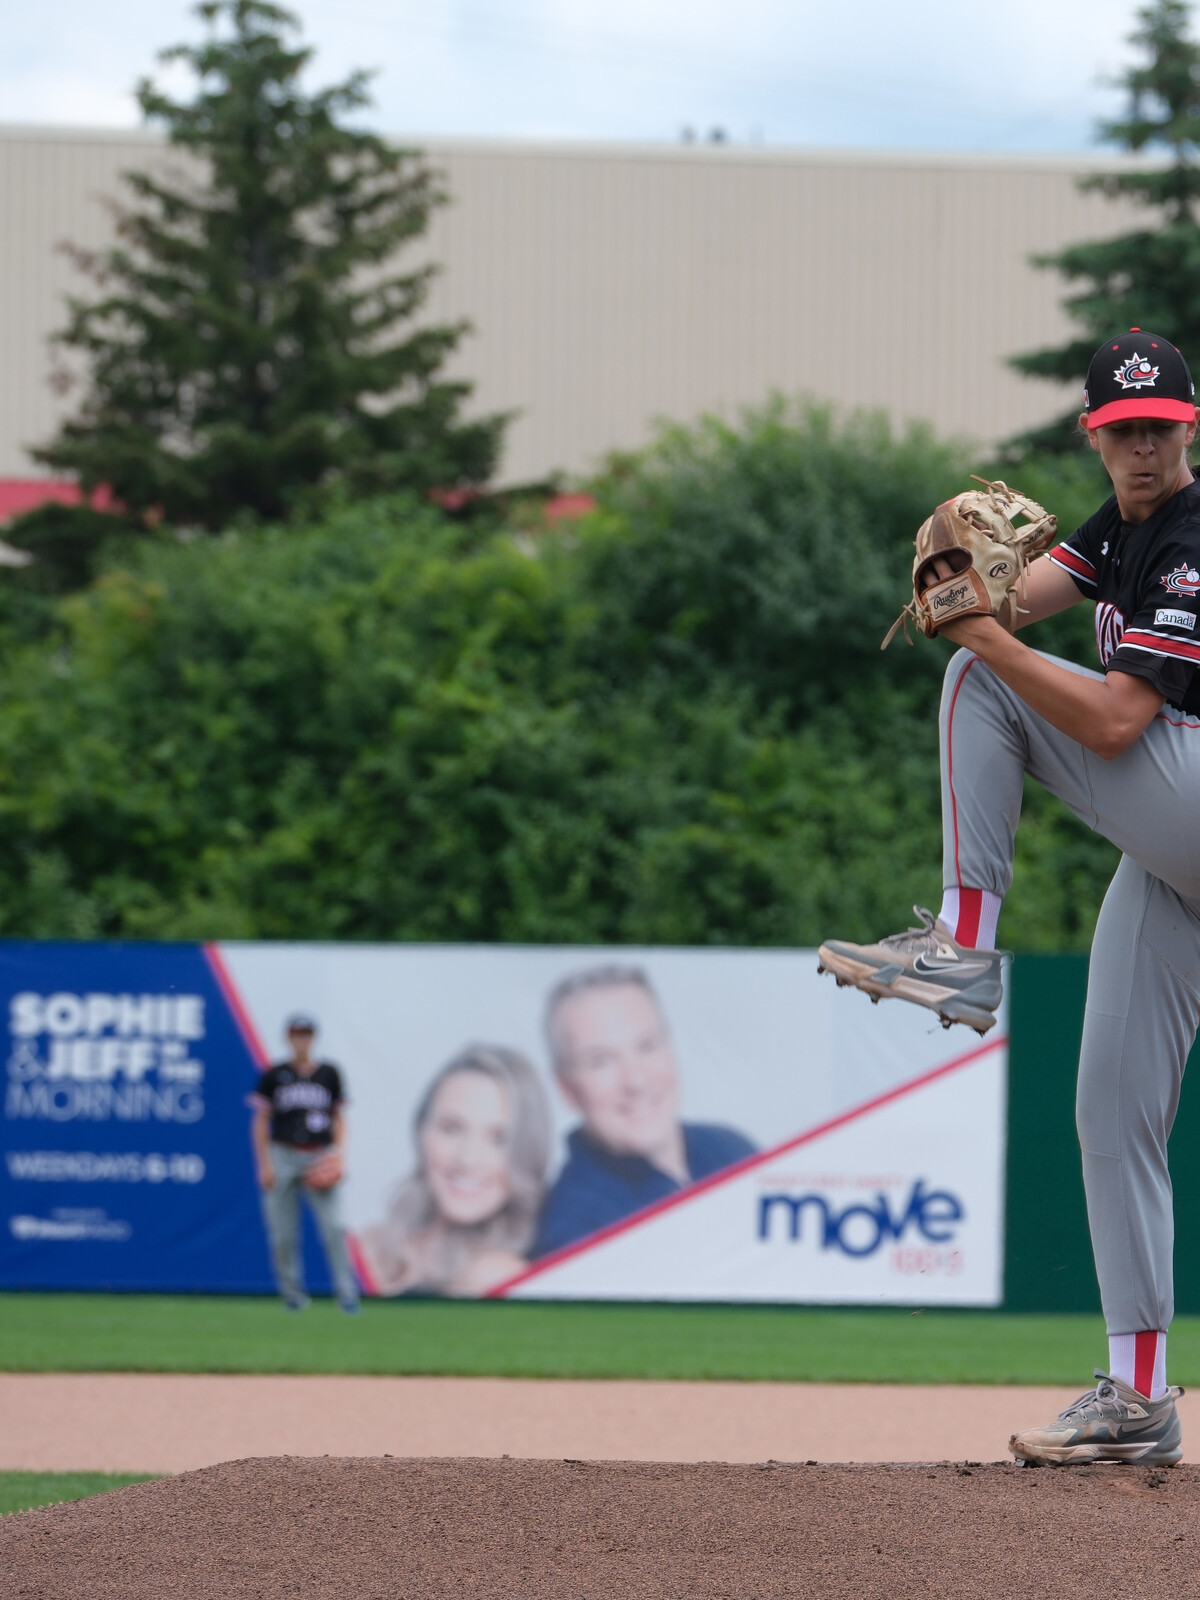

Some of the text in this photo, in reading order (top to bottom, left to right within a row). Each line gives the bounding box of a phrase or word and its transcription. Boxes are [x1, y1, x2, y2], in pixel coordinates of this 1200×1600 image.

[933, 584, 969, 610] Rawlings
[1156, 610, 1194, 628] Canada
[9, 993, 205, 1039] SOPHIE
[7, 1037, 154, 1082] & JEFF
[6, 1081, 204, 1122] MORNING
[8, 1152, 144, 1182] WEEKDAYS
[758, 1179, 963, 1259] move
